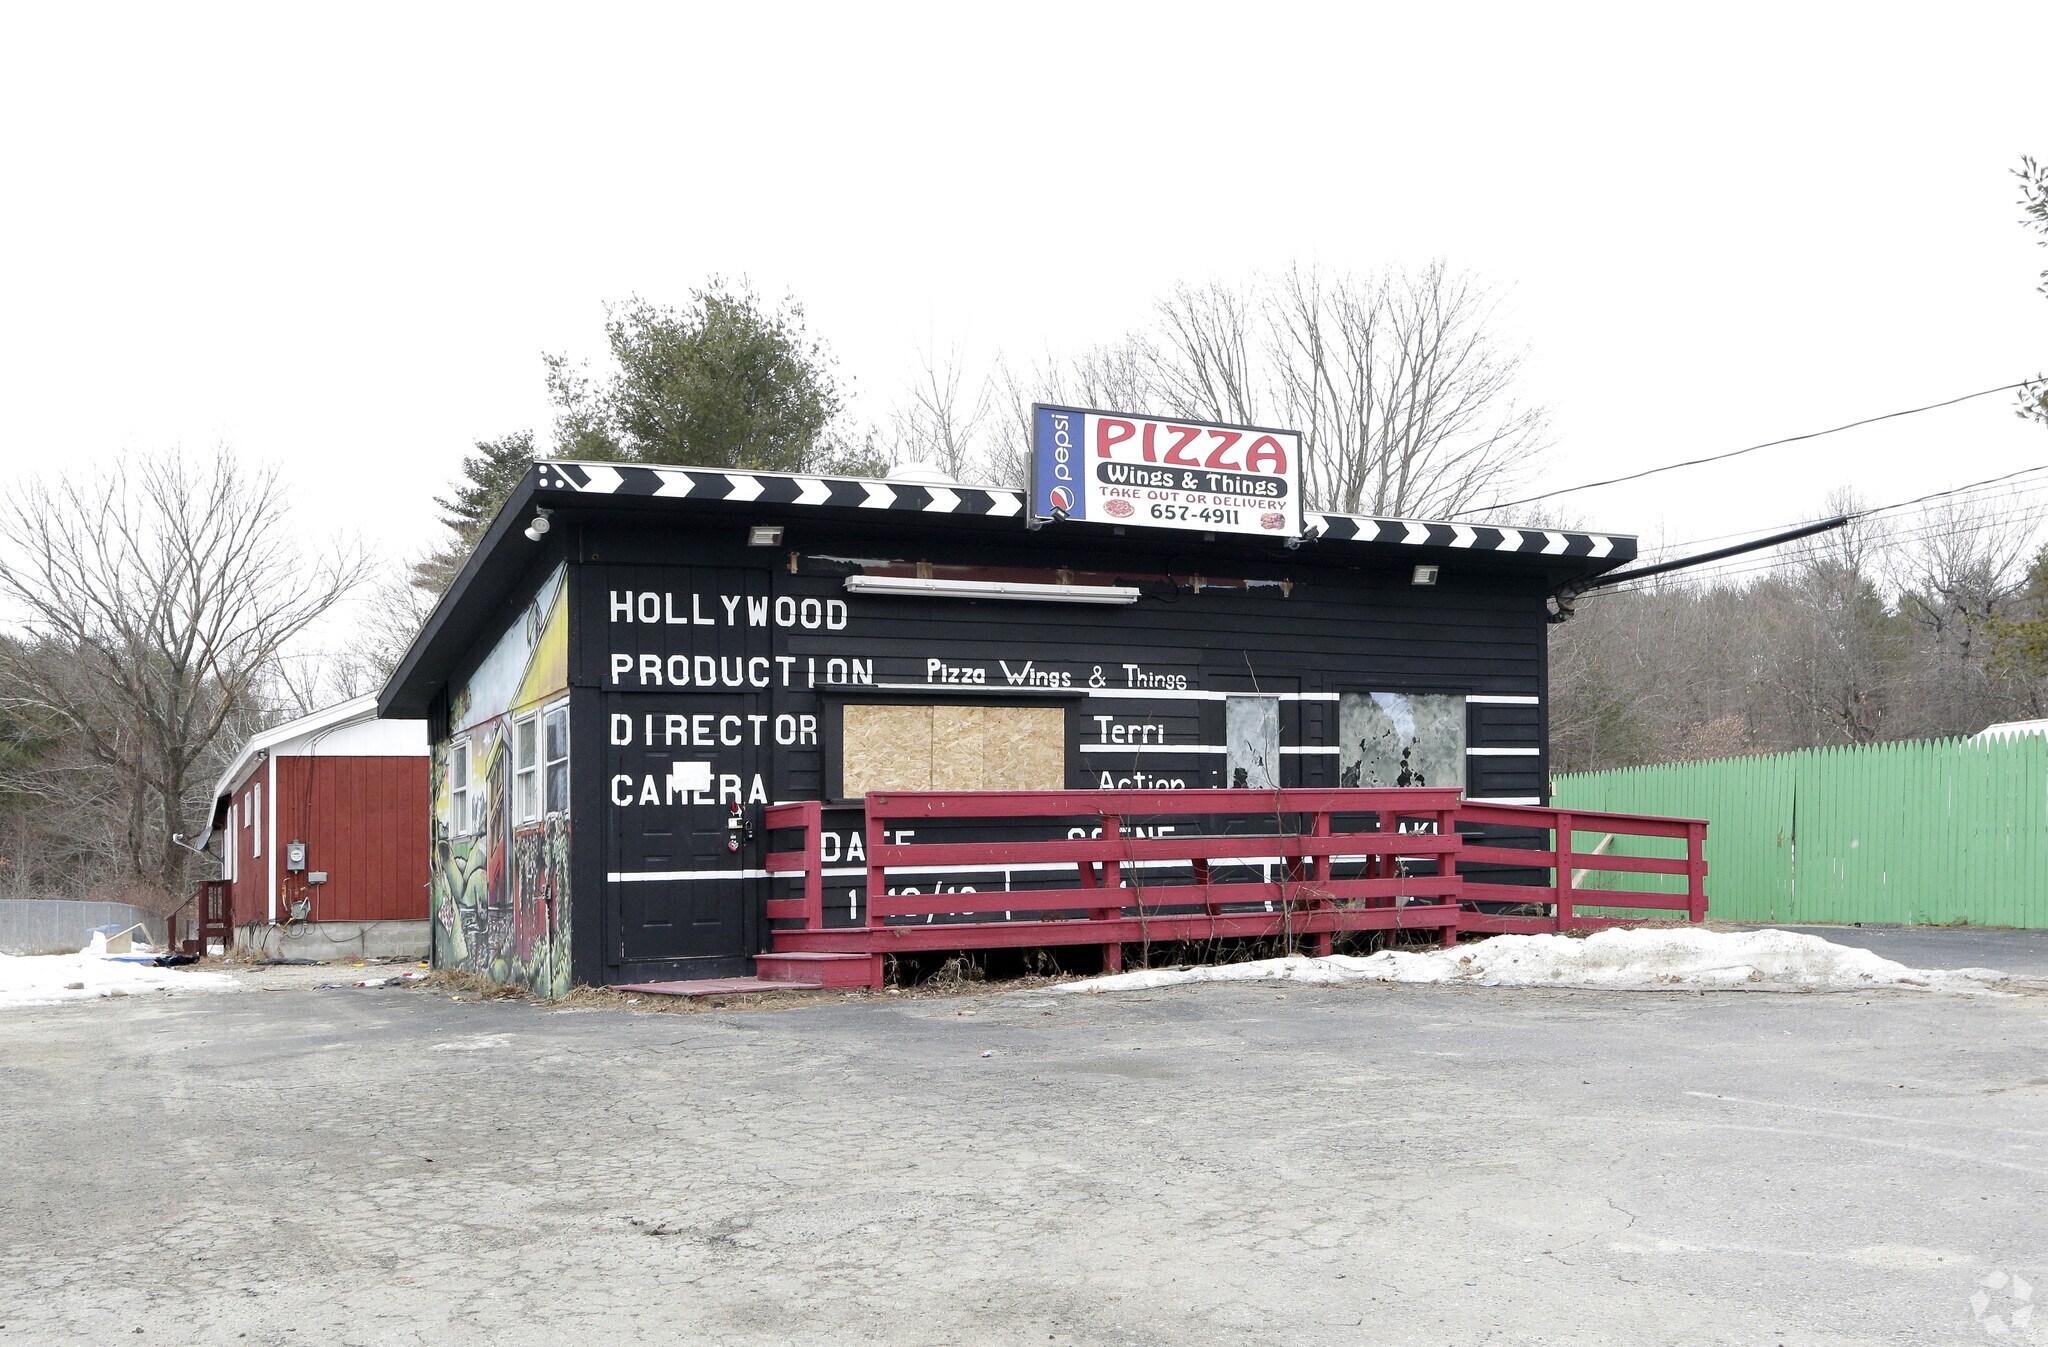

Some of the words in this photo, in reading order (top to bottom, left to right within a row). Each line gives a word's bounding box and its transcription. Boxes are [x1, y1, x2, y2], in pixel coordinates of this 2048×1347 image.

[1052, 413, 1072, 481] pepsi
[1096, 417, 1287, 474] PIZZA
[1107, 464, 1174, 489] Wings
[1181, 472, 1199, 489] &
[1206, 472, 1278, 496] Things
[1099, 486, 1141, 499] TAKE
[1149, 490, 1180, 502] OUT
[1186, 493, 1207, 505] OR
[1213, 495, 1287, 510] DELIVERY
[1150, 503, 1239, 525] 657-4911
[610, 590, 848, 630] HOLLYWOOD
[610, 653, 873, 688] PRODUCTION
[927, 657, 985, 684] Pizza
[999, 660, 1072, 688] Wings
[1088, 665, 1107, 688] &
[1122, 664, 1187, 690] Things
[610, 713, 818, 746] DIRECTOR
[1093, 715, 1164, 744] Terri
